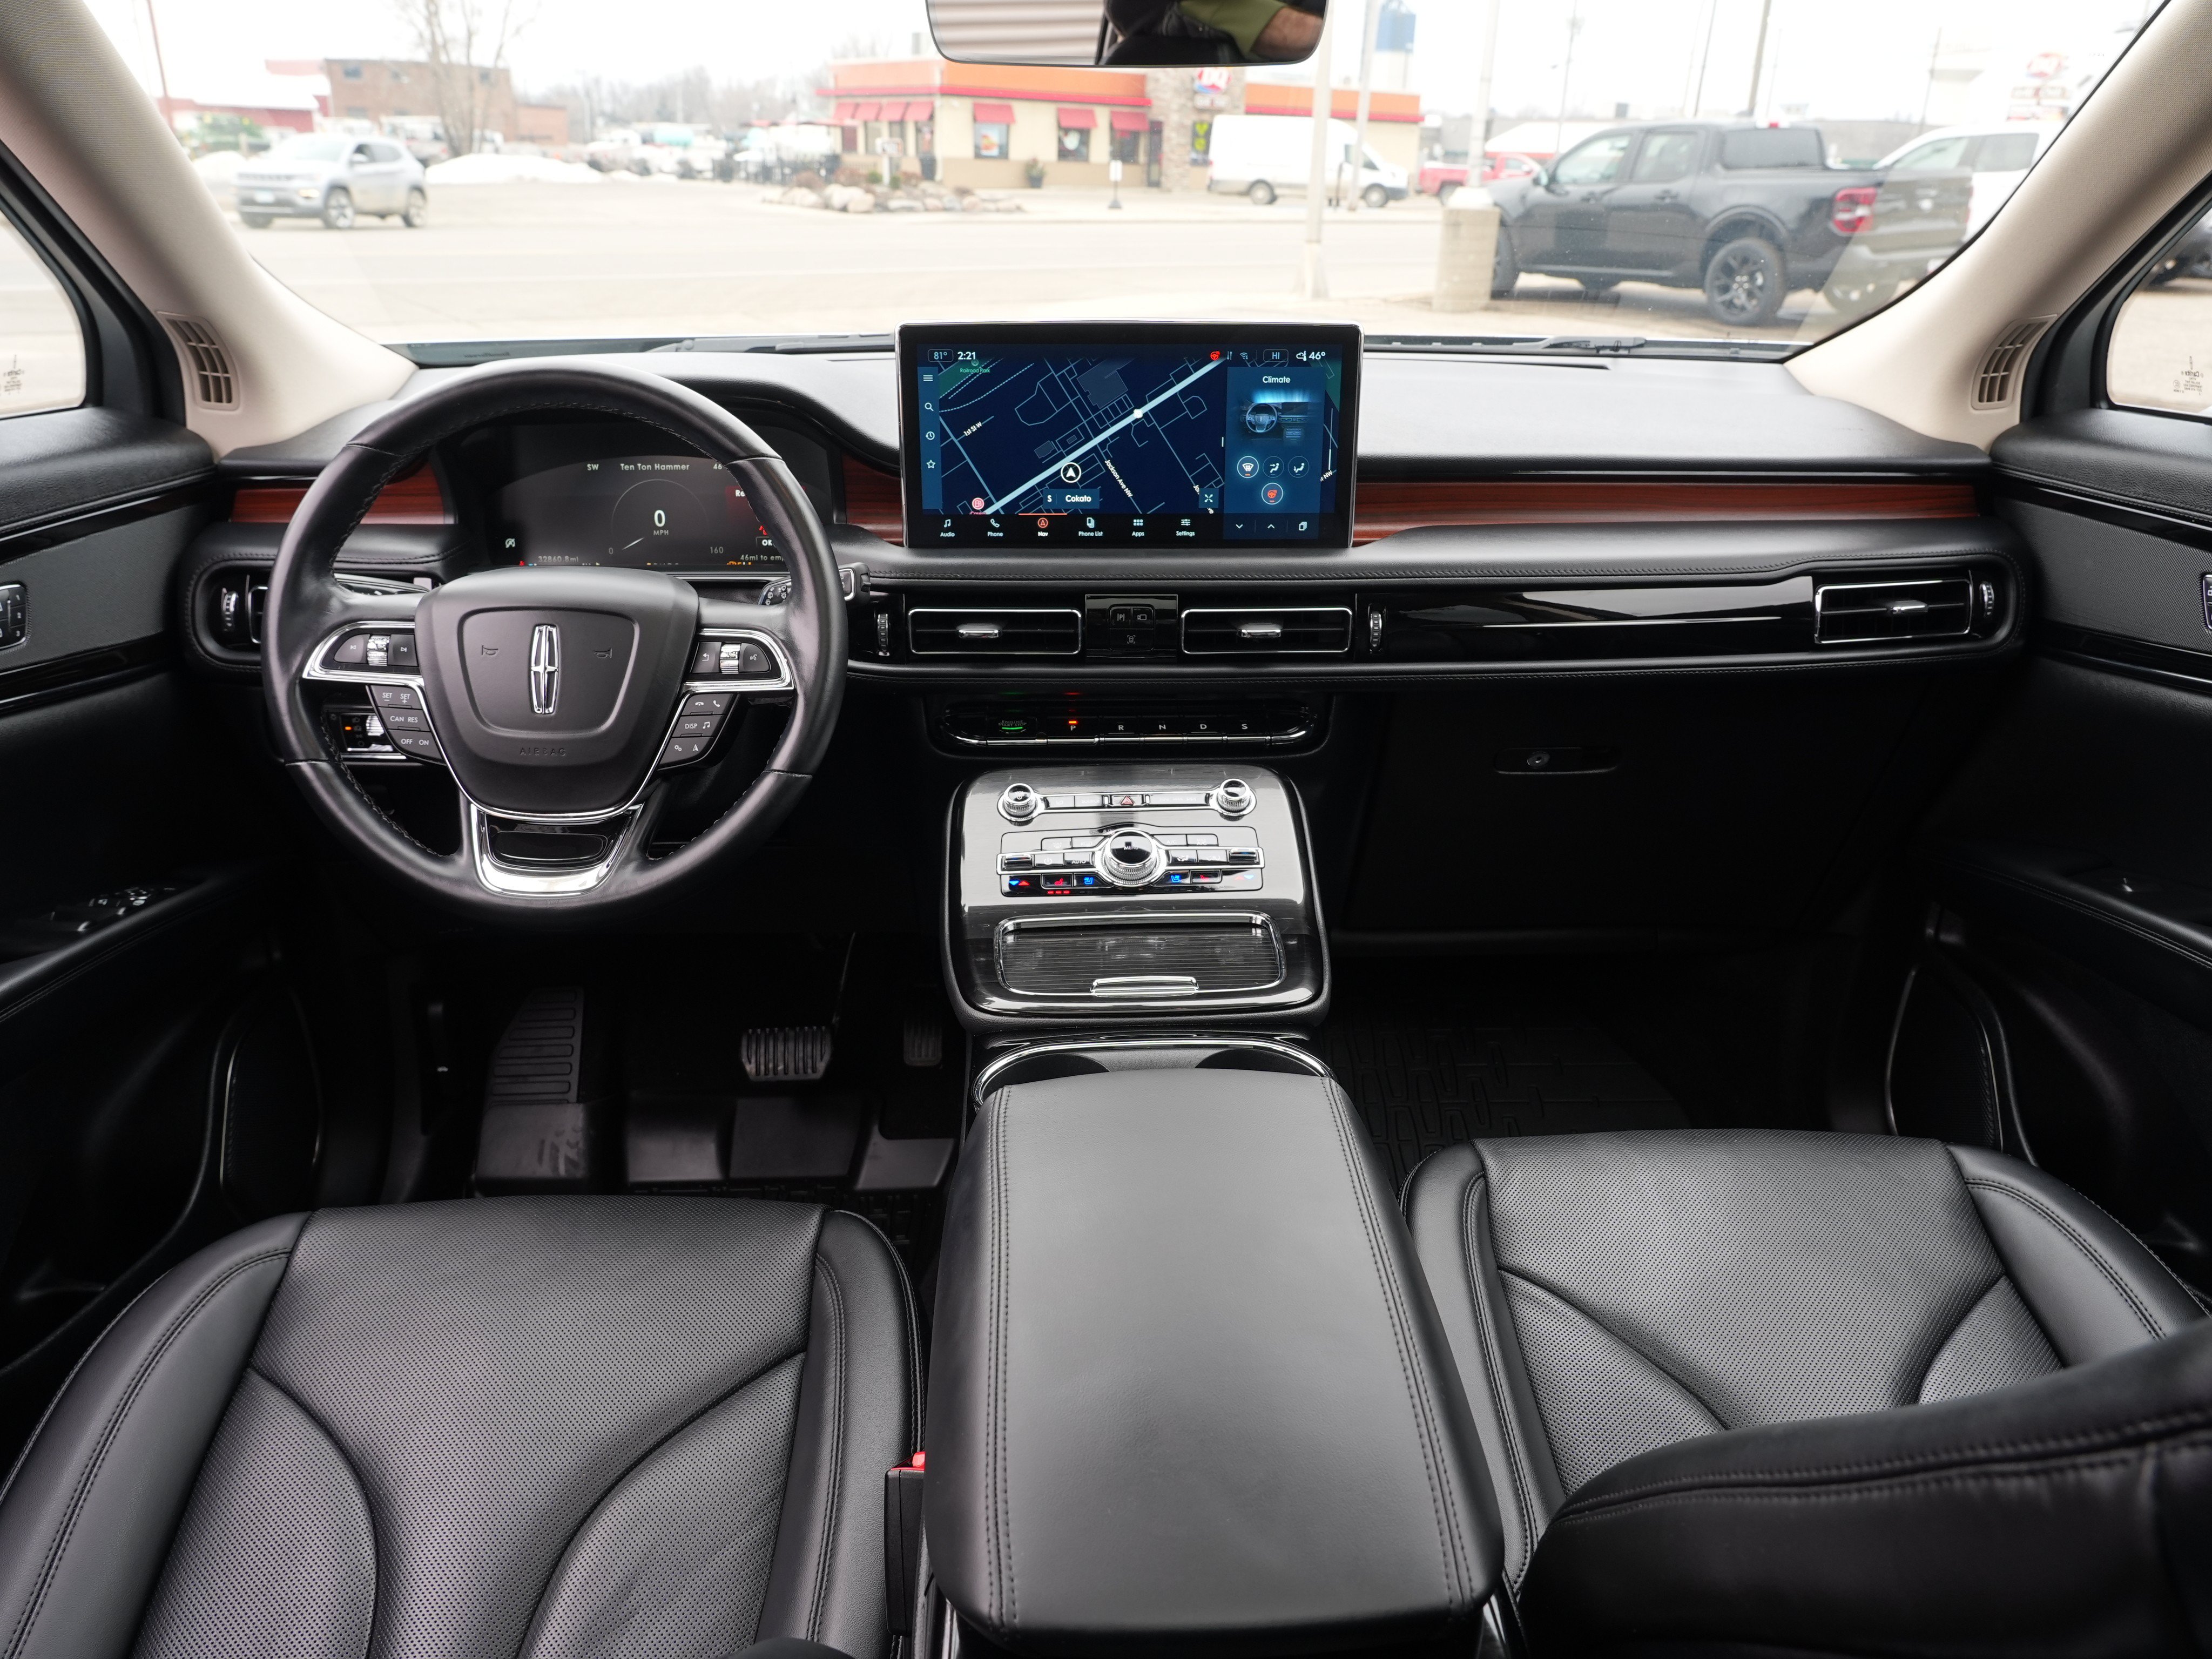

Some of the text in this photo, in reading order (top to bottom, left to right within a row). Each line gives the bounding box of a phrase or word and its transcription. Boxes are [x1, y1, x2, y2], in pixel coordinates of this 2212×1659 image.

[957, 351, 976, 360] 2:21
[1272, 352, 1280, 360] HI
[1309, 351, 1326, 360] 46°
[1262, 375, 1291, 383] Climate
[963, 428, 972, 436] 1st
[1104, 460, 1133, 497] Jackson Ave NW
[1047, 495, 1092, 503] S Cokato
[653, 509, 666, 528] 0
[520, 747, 567, 756] AIRBAG
